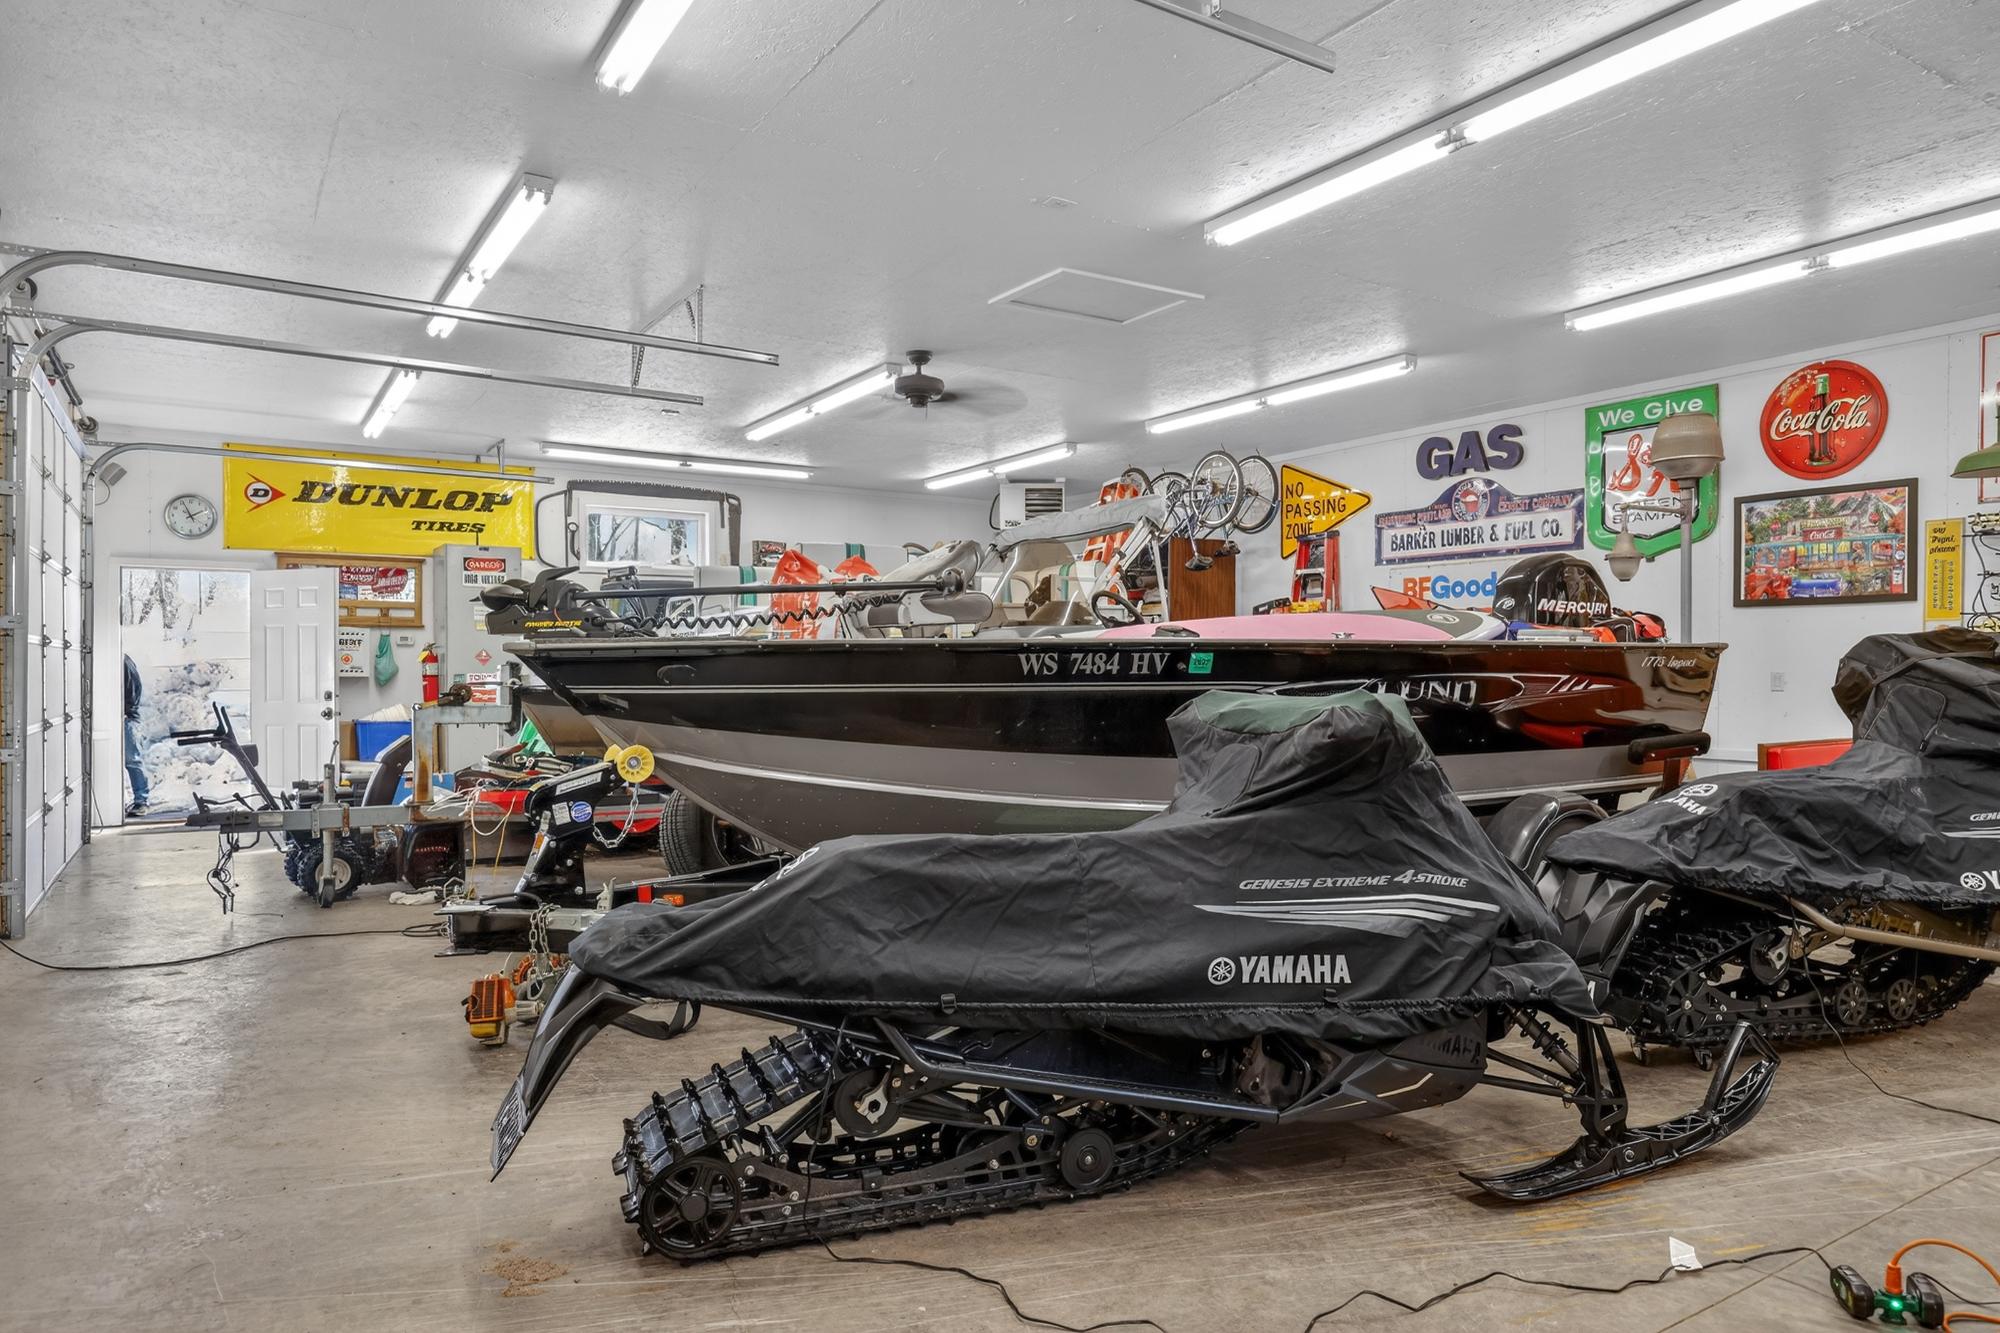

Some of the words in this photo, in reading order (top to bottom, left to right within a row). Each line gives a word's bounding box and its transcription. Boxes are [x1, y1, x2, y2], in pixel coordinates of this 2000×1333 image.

[1598, 408, 1635, 427] We
[1643, 398, 1704, 419] Give
[1770, 394, 1872, 440] Coca-Cola
[1416, 423, 1524, 480] GAS
[292, 480, 512, 513] DUNLOP
[1285, 482, 1304, 499] NO
[1285, 497, 1346, 519] PASSING
[1612, 497, 1682, 513] GEEN
[411, 520, 485, 533] TIRES
[1612, 510, 1687, 525] SAMPS
[1391, 531, 1436, 552] BARKER
[1441, 527, 1485, 547] LUMBER
[1490, 524, 1500, 542] &
[1505, 520, 1536, 541] FUEL
[1542, 518, 1563, 538] CO.
[1537, 598, 1608, 615] MERCURY
[1018, 652, 1058, 675] WS
[1070, 652, 1120, 675] 7484
[1129, 652, 1171, 675] HV
[1239, 878, 1310, 890] GENESIS
[1313, 875, 1391, 888] EXTREME
[1394, 869, 1469, 888] 4-STROKE
[1240, 954, 1352, 984] YAMAHA
